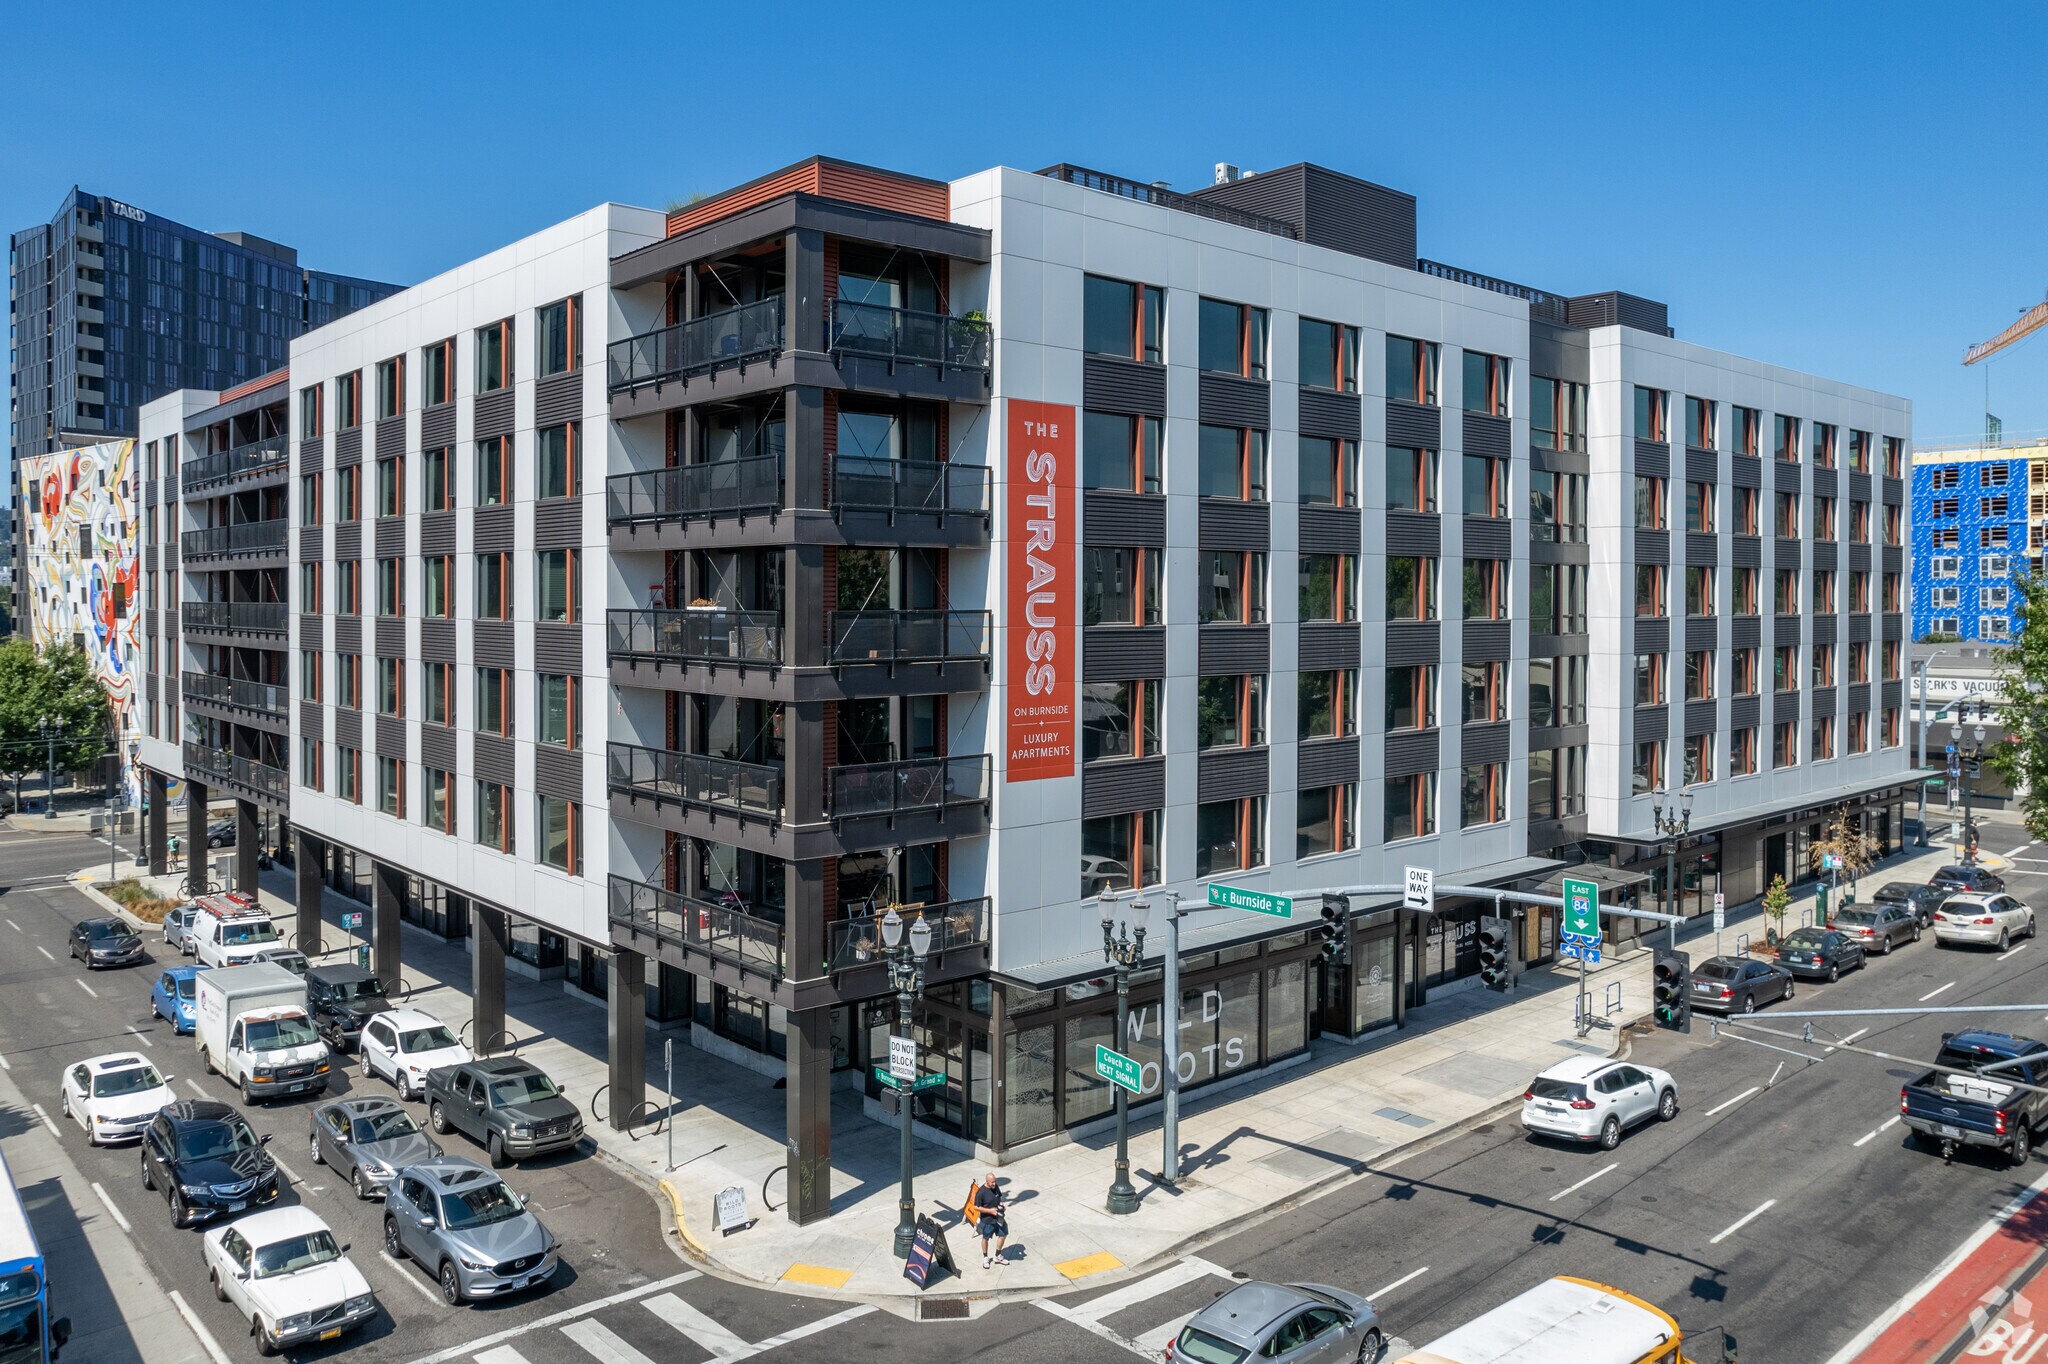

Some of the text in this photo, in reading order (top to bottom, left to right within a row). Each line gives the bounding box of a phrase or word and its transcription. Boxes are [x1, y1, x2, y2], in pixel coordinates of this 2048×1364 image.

[110, 200, 146, 222] YARD
[1024, 421, 1058, 438] THE
[1025, 449, 1057, 696] STRAUSS
[1913, 679, 1957, 690] SRK'S
[1014, 705, 1069, 717] ON BURNSIDE
[1023, 732, 1059, 744] LUXURY
[1011, 745, 1070, 760] APARTMENTS
[1409, 870, 1428, 882] ONE
[1409, 883, 1428, 894] WAY
[1571, 884, 1589, 895] EAST
[1222, 891, 1272, 911] E Burnside
[1573, 900, 1588, 912] 84
[1430, 926, 1442, 934] THE
[891, 1041, 914, 1055] DO NOT
[891, 1054, 914, 1068] BLOCK
[1104, 1052, 1133, 1074] Couch St
[1098, 1061, 1138, 1089] NEXT SIGNAL
[1965, 1318, 2048, 1364] BU
